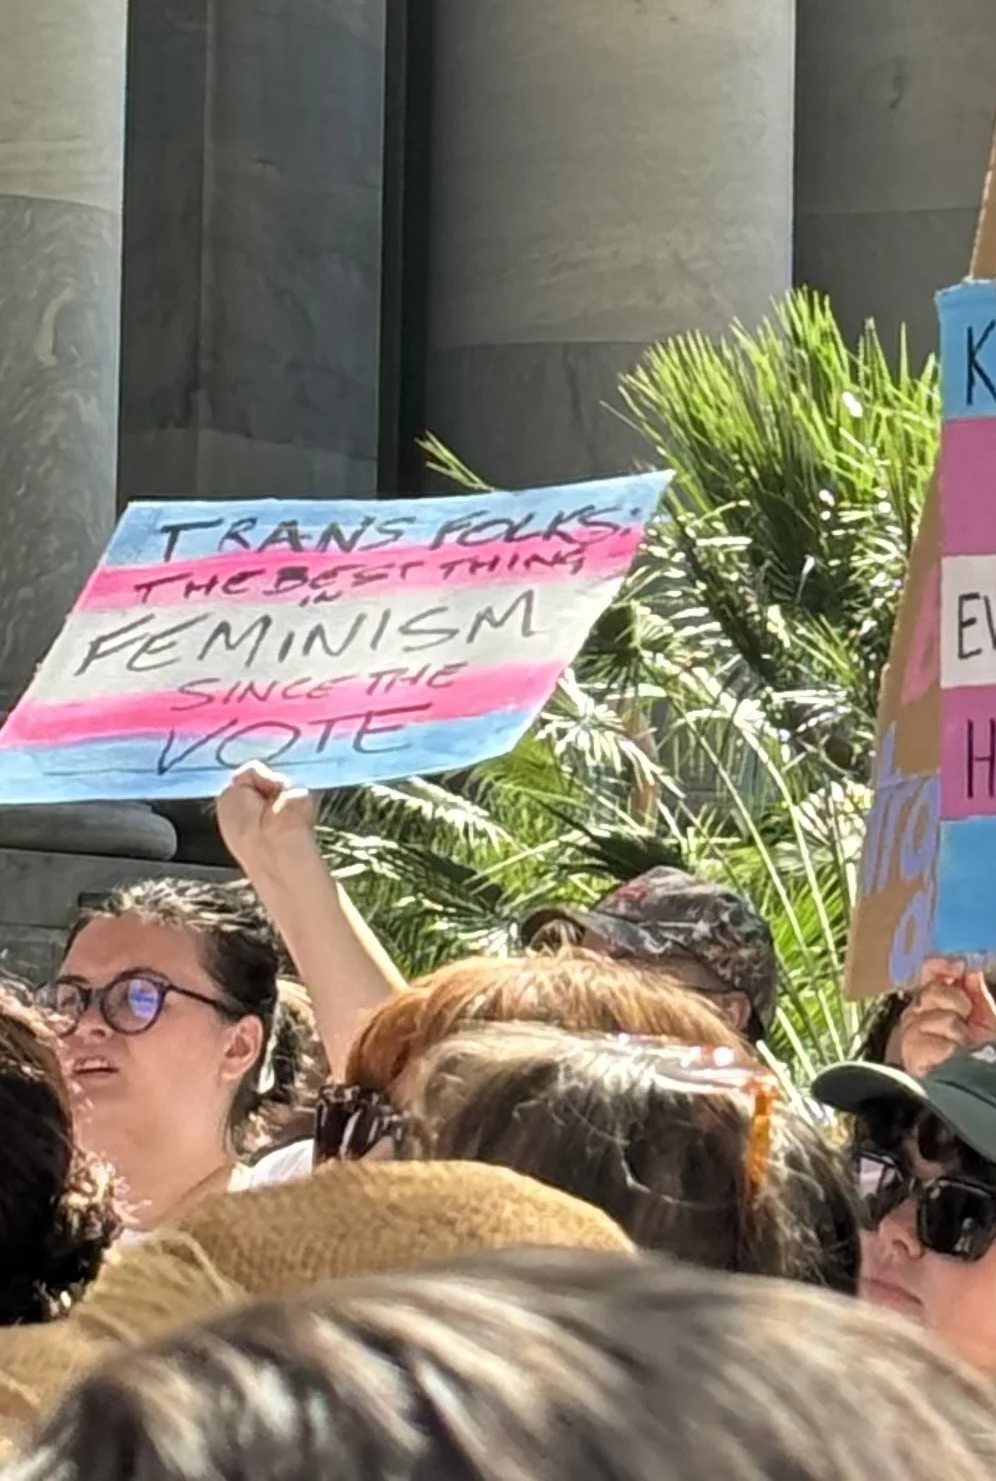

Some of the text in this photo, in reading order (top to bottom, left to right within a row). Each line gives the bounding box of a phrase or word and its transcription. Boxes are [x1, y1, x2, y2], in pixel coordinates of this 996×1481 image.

[158, 516, 402, 563] TRANS
[133, 546, 588, 604] THE BEST THING
[73, 589, 541, 677] FEMINISM
[170, 662, 470, 713] SINCE THE
[156, 702, 433, 777] VOTE
